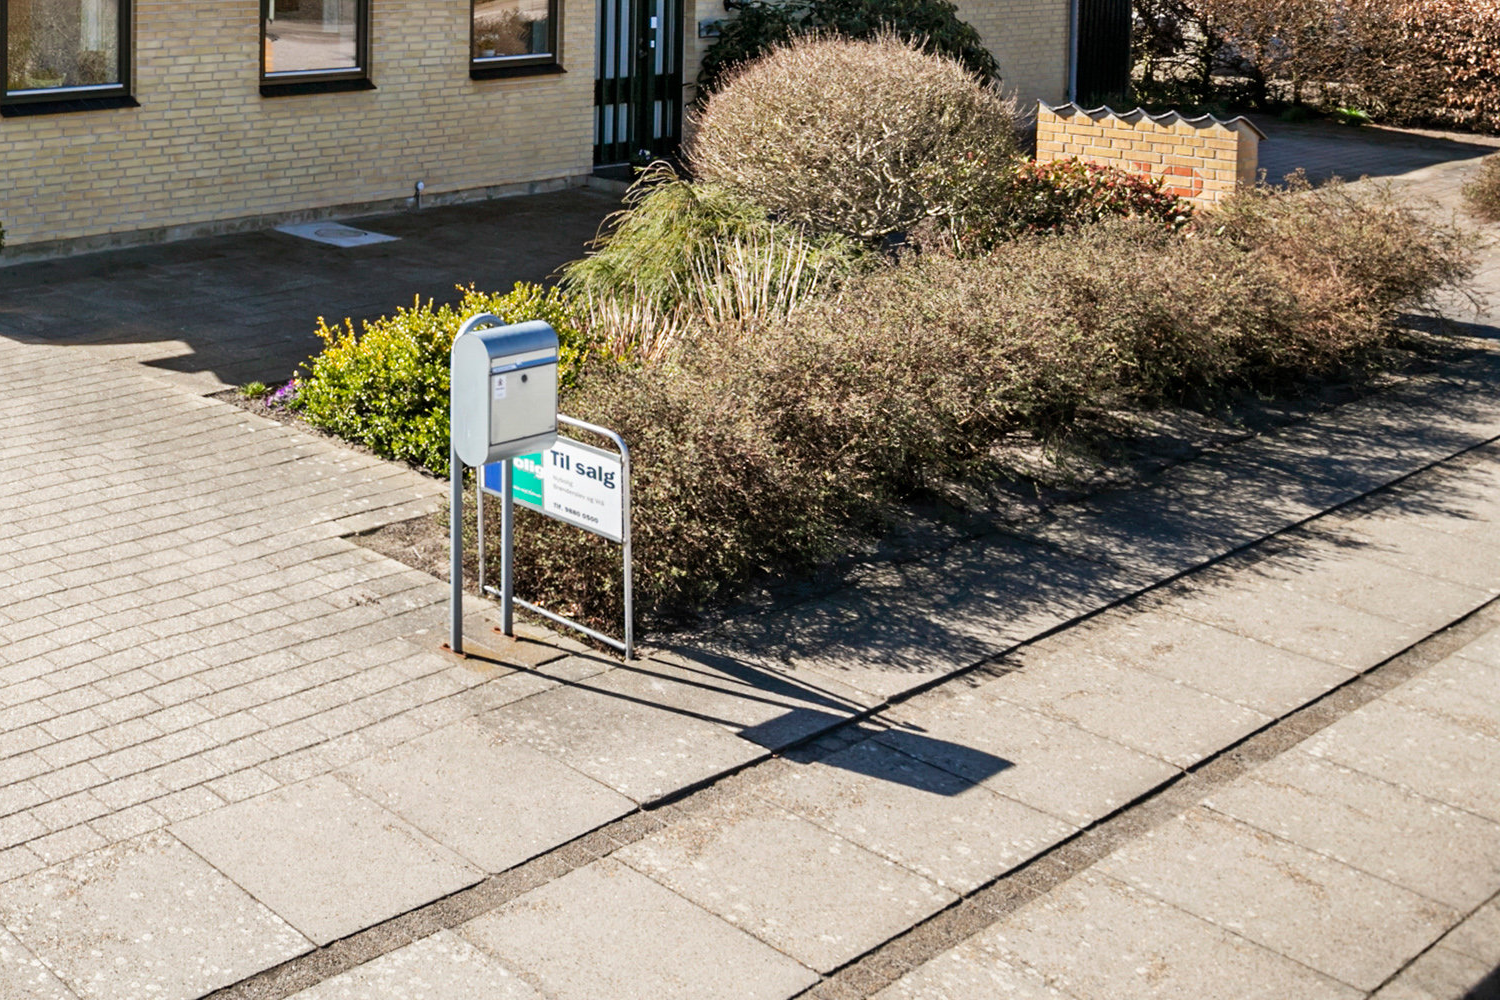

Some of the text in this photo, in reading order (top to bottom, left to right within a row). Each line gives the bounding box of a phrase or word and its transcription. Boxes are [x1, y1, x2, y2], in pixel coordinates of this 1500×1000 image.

[513, 456, 545, 479] olig
[550, 450, 569, 470] Til
[576, 463, 615, 489] salg
